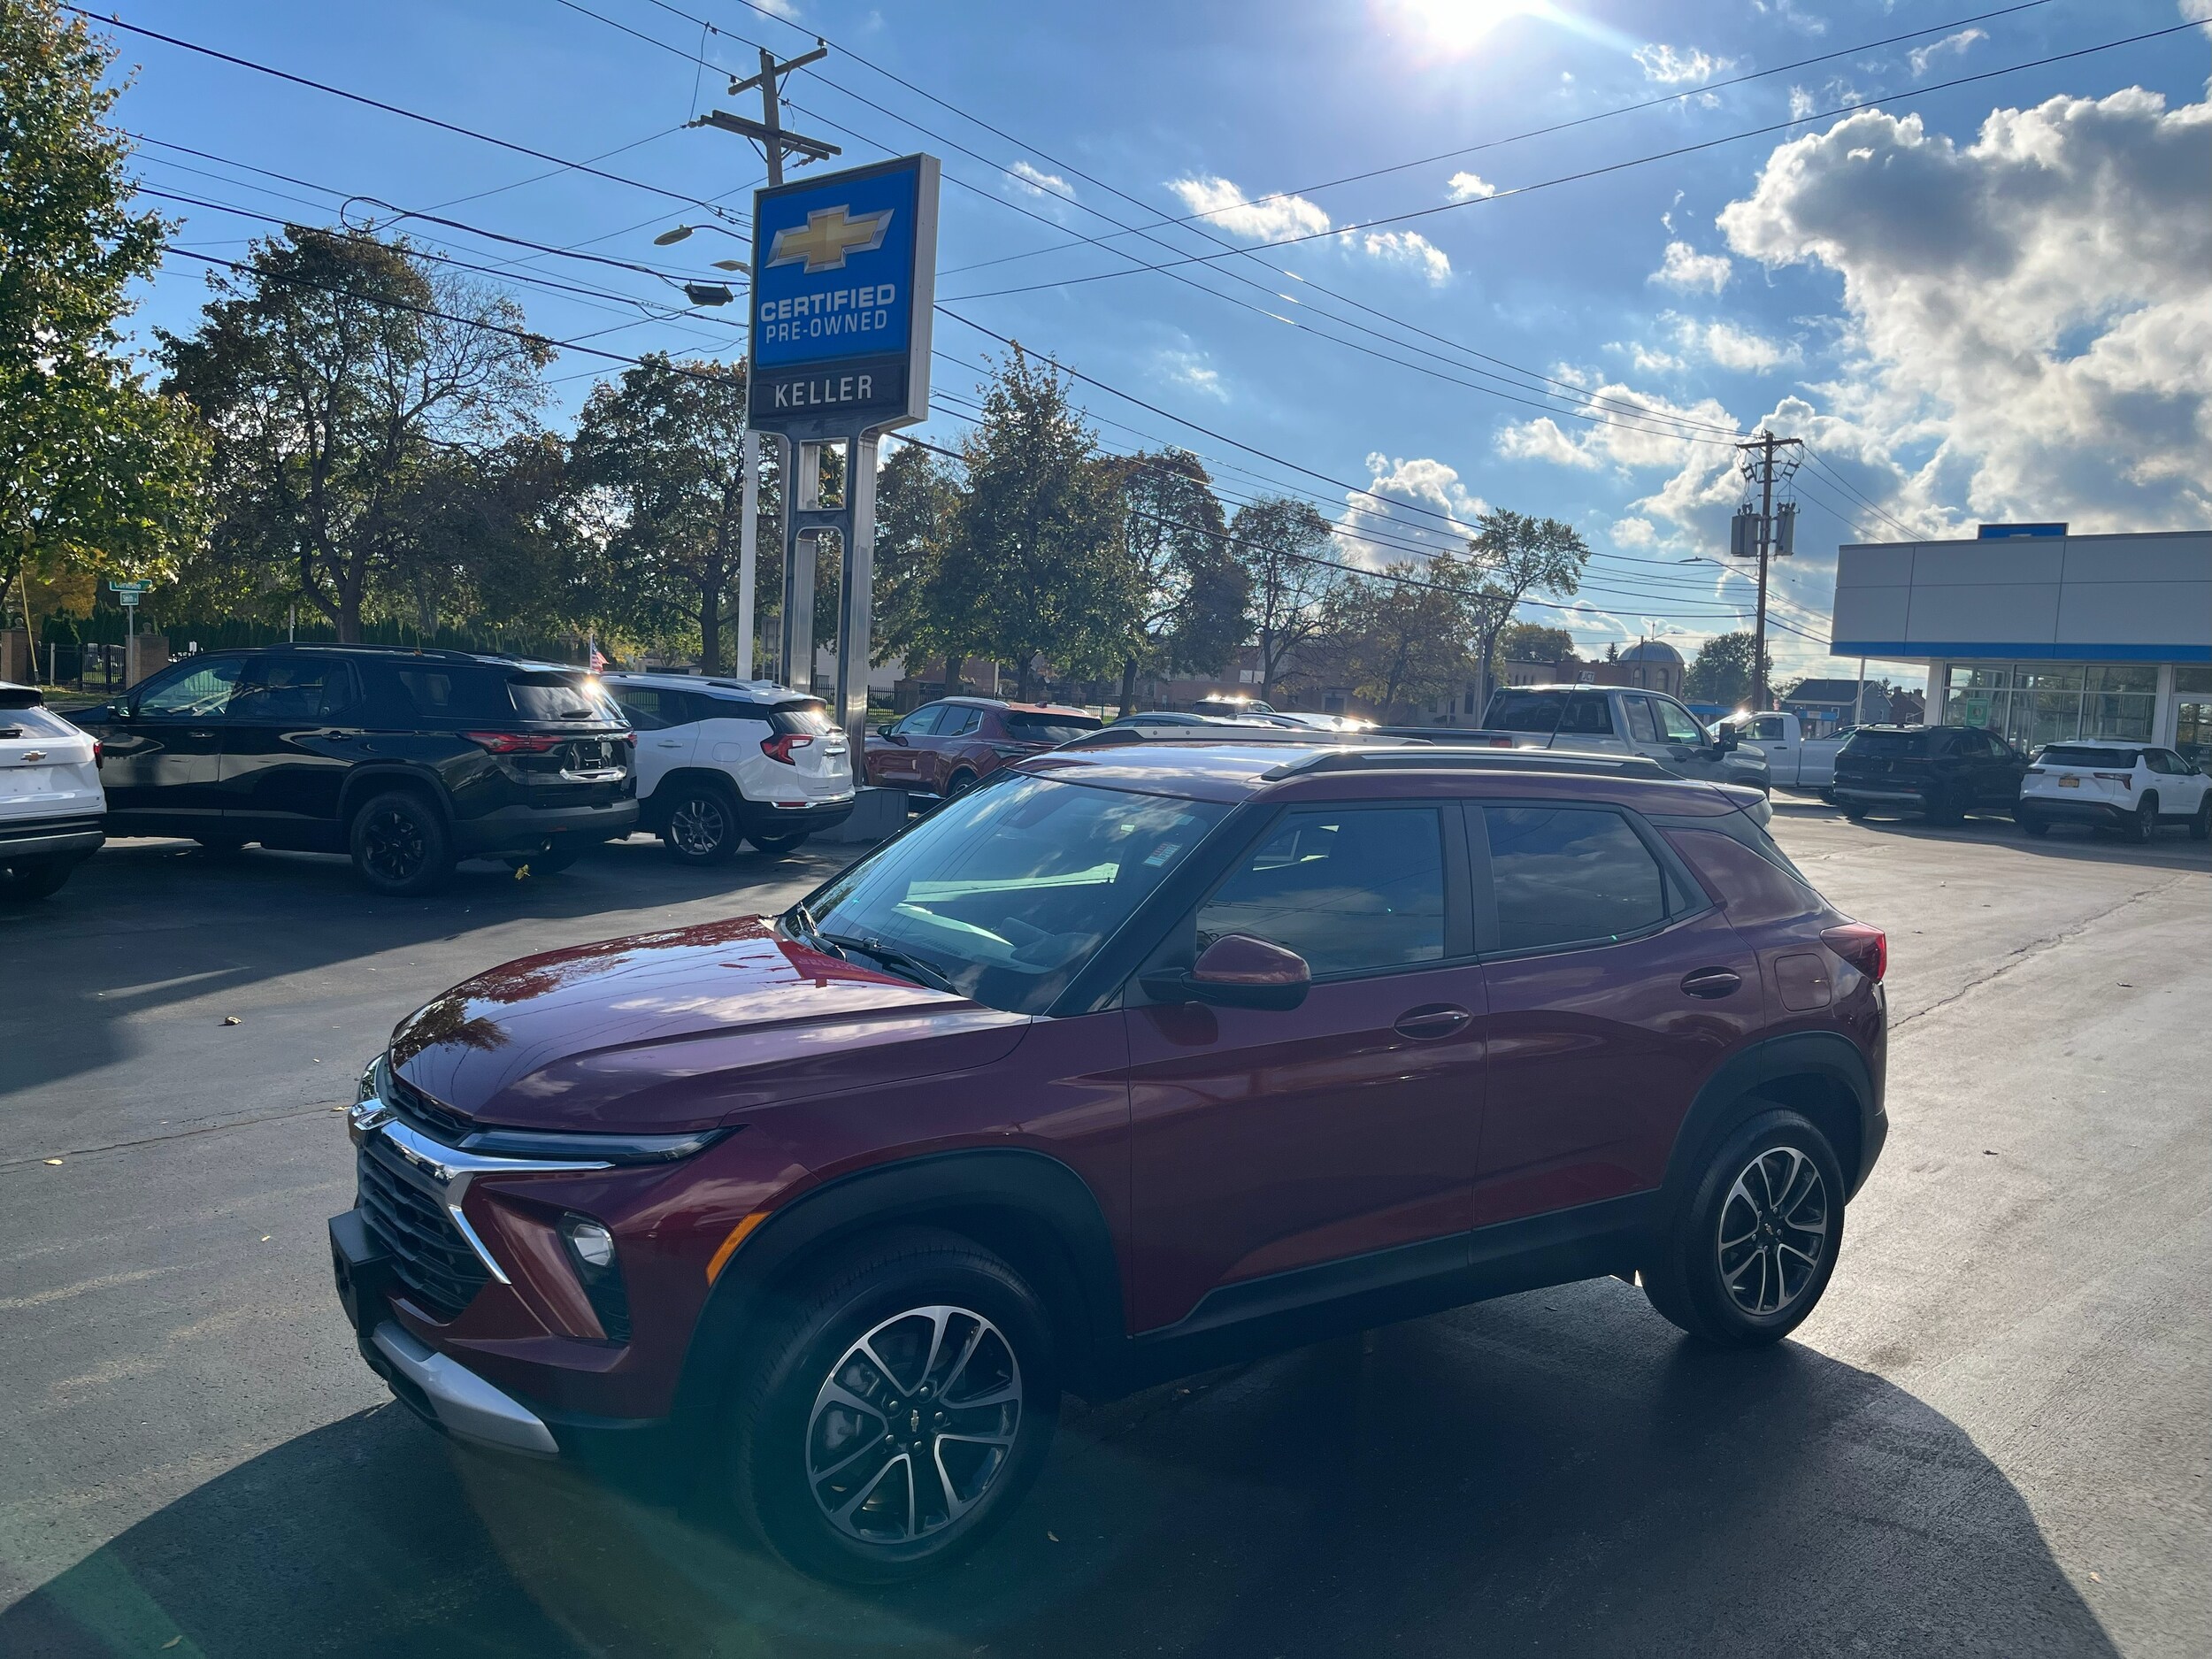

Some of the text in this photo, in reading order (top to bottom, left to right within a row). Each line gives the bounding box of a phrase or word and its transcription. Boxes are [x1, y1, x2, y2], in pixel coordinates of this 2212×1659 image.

[760, 283, 895, 322] CERTIFIED
[766, 310, 887, 343] PRE-OWNED
[775, 374, 872, 408] KELLER
